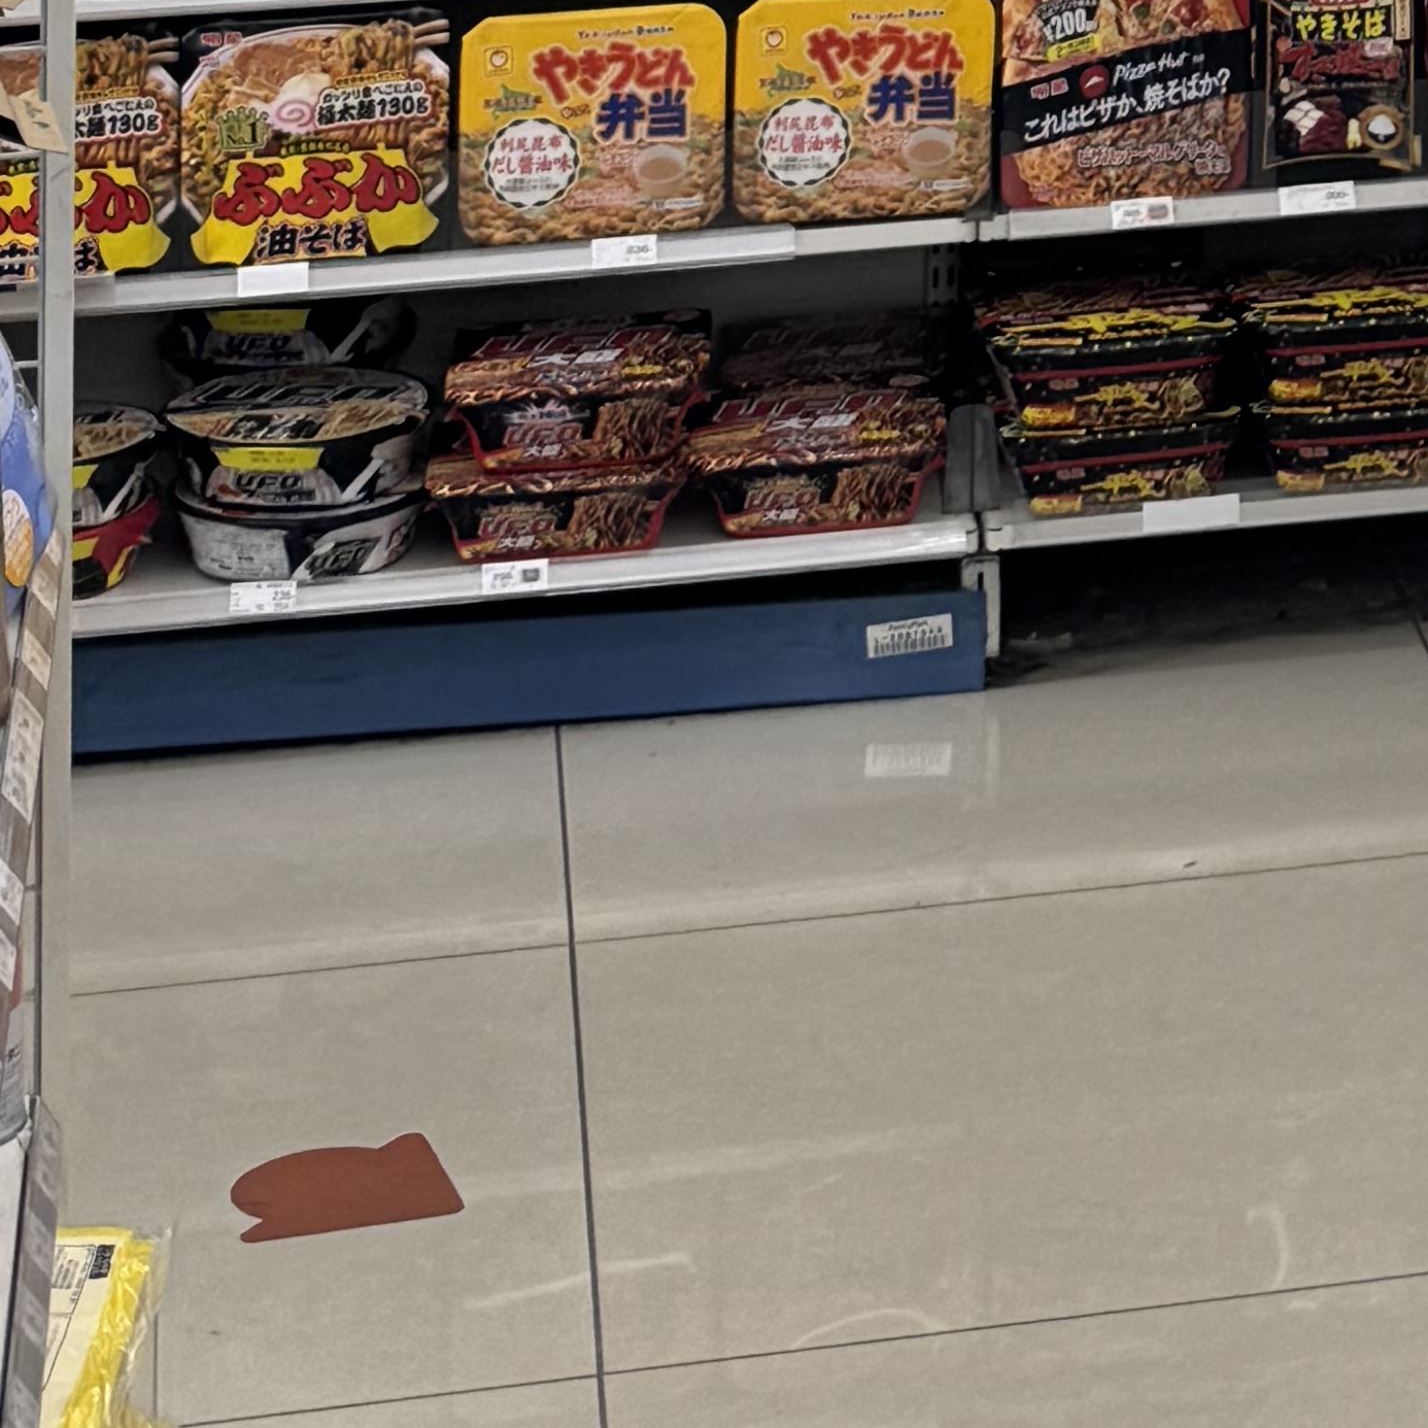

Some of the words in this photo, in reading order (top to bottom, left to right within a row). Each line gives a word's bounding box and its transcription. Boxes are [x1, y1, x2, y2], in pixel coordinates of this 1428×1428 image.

[1296, 10, 1389, 41] やきそば
[530, 40, 697, 107] やきうどん
[807, 24, 965, 81] やきうどん
[1113, 59, 1148, 85] Pizza
[597, 92, 689, 141] 弁当
[866, 75, 958, 122] 弁当
[212, 154, 424, 228] ぶぶか
[256, 220, 367, 257] 油そば
